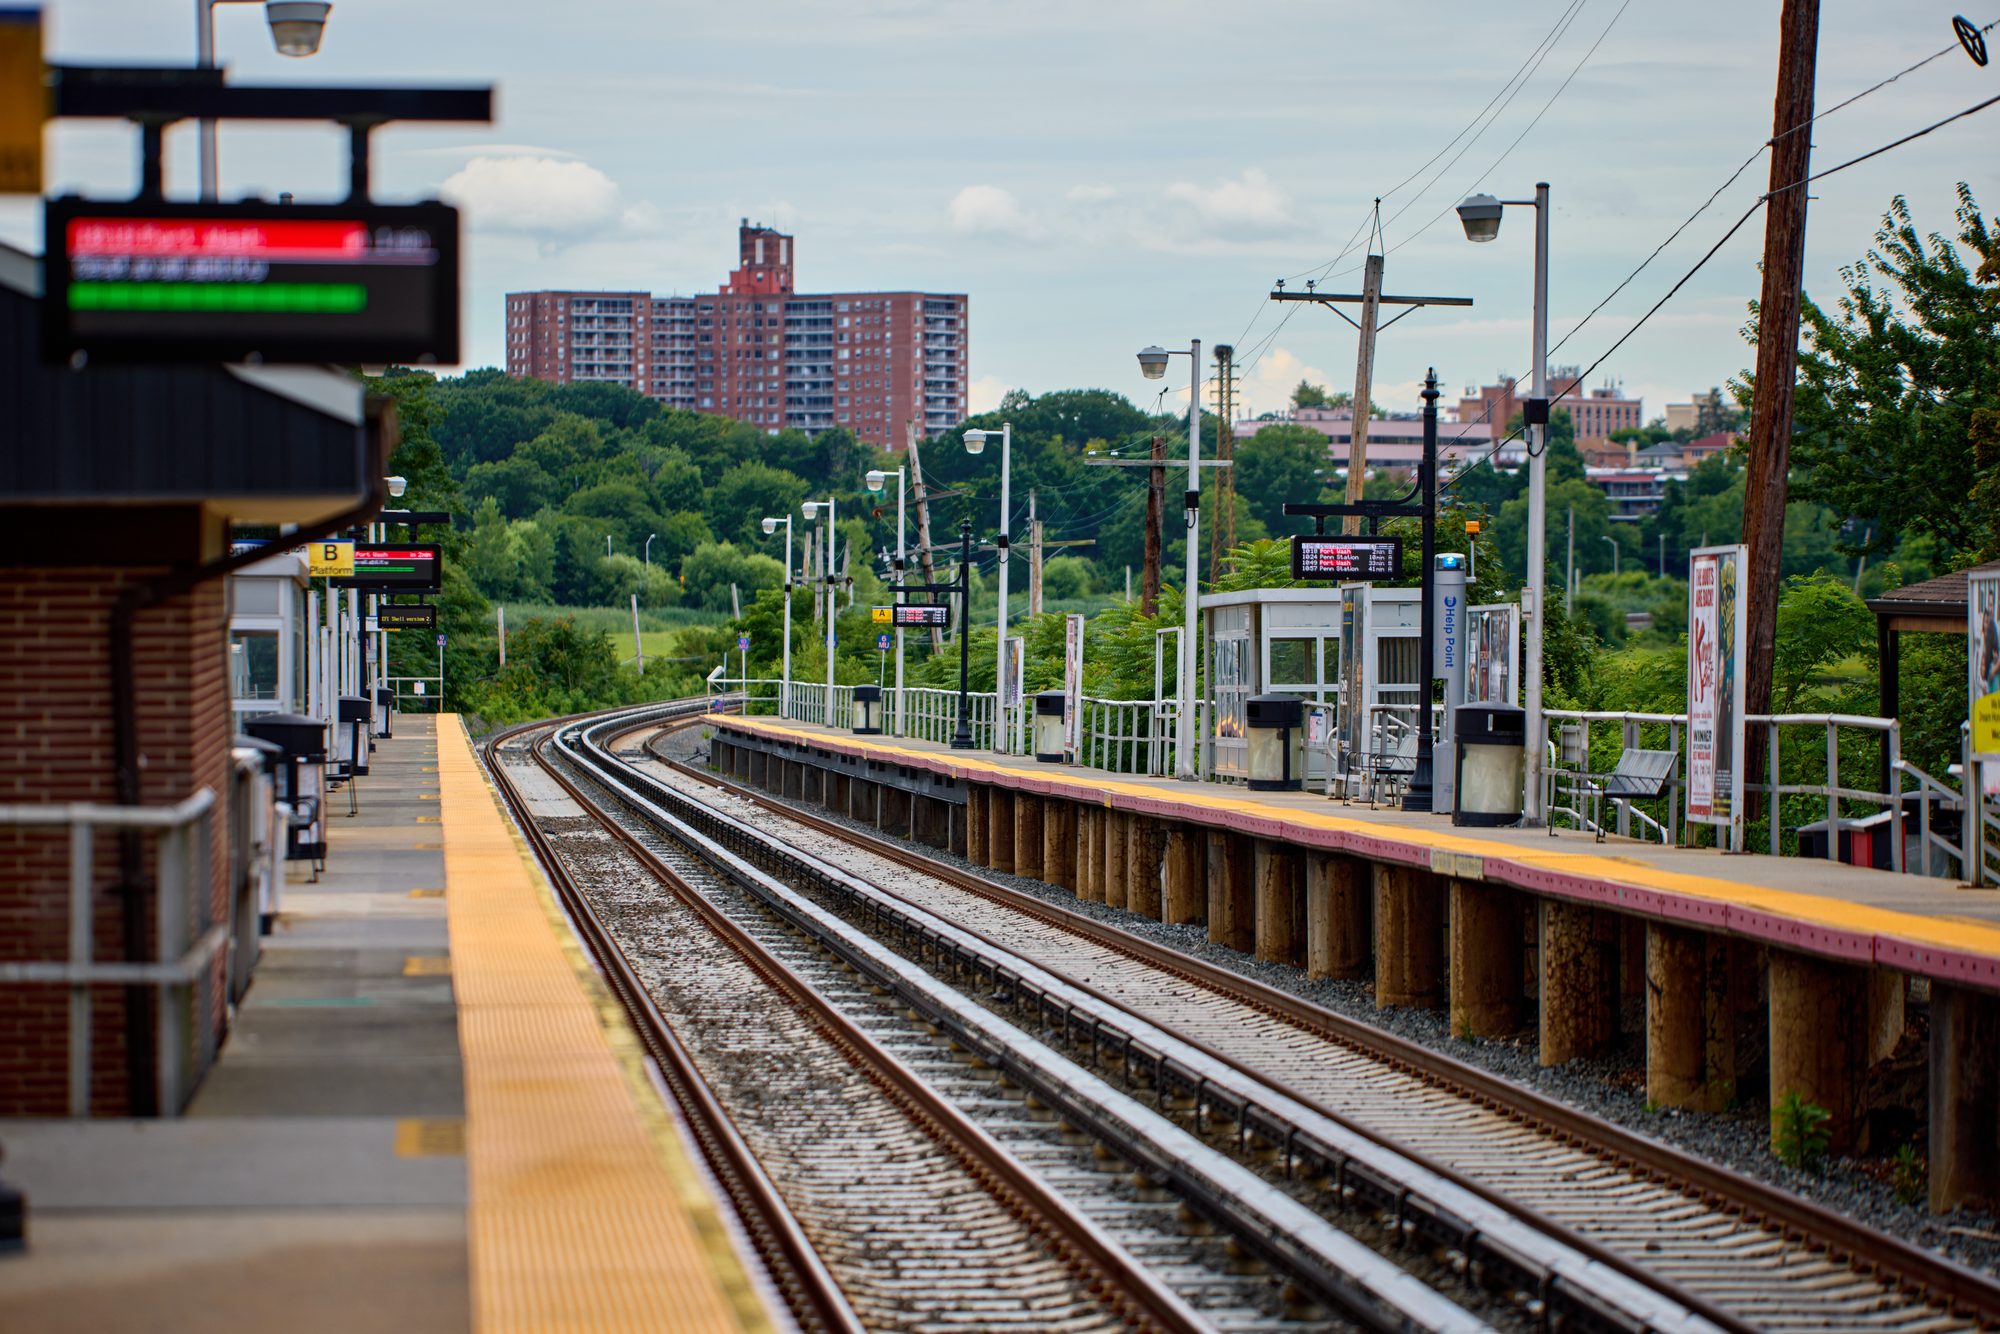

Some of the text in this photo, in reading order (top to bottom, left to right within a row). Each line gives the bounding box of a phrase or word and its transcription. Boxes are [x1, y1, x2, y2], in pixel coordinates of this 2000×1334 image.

[323, 545, 338, 561] B
[309, 566, 353, 576] Platform
[1443, 609, 1456, 668] Help Point
